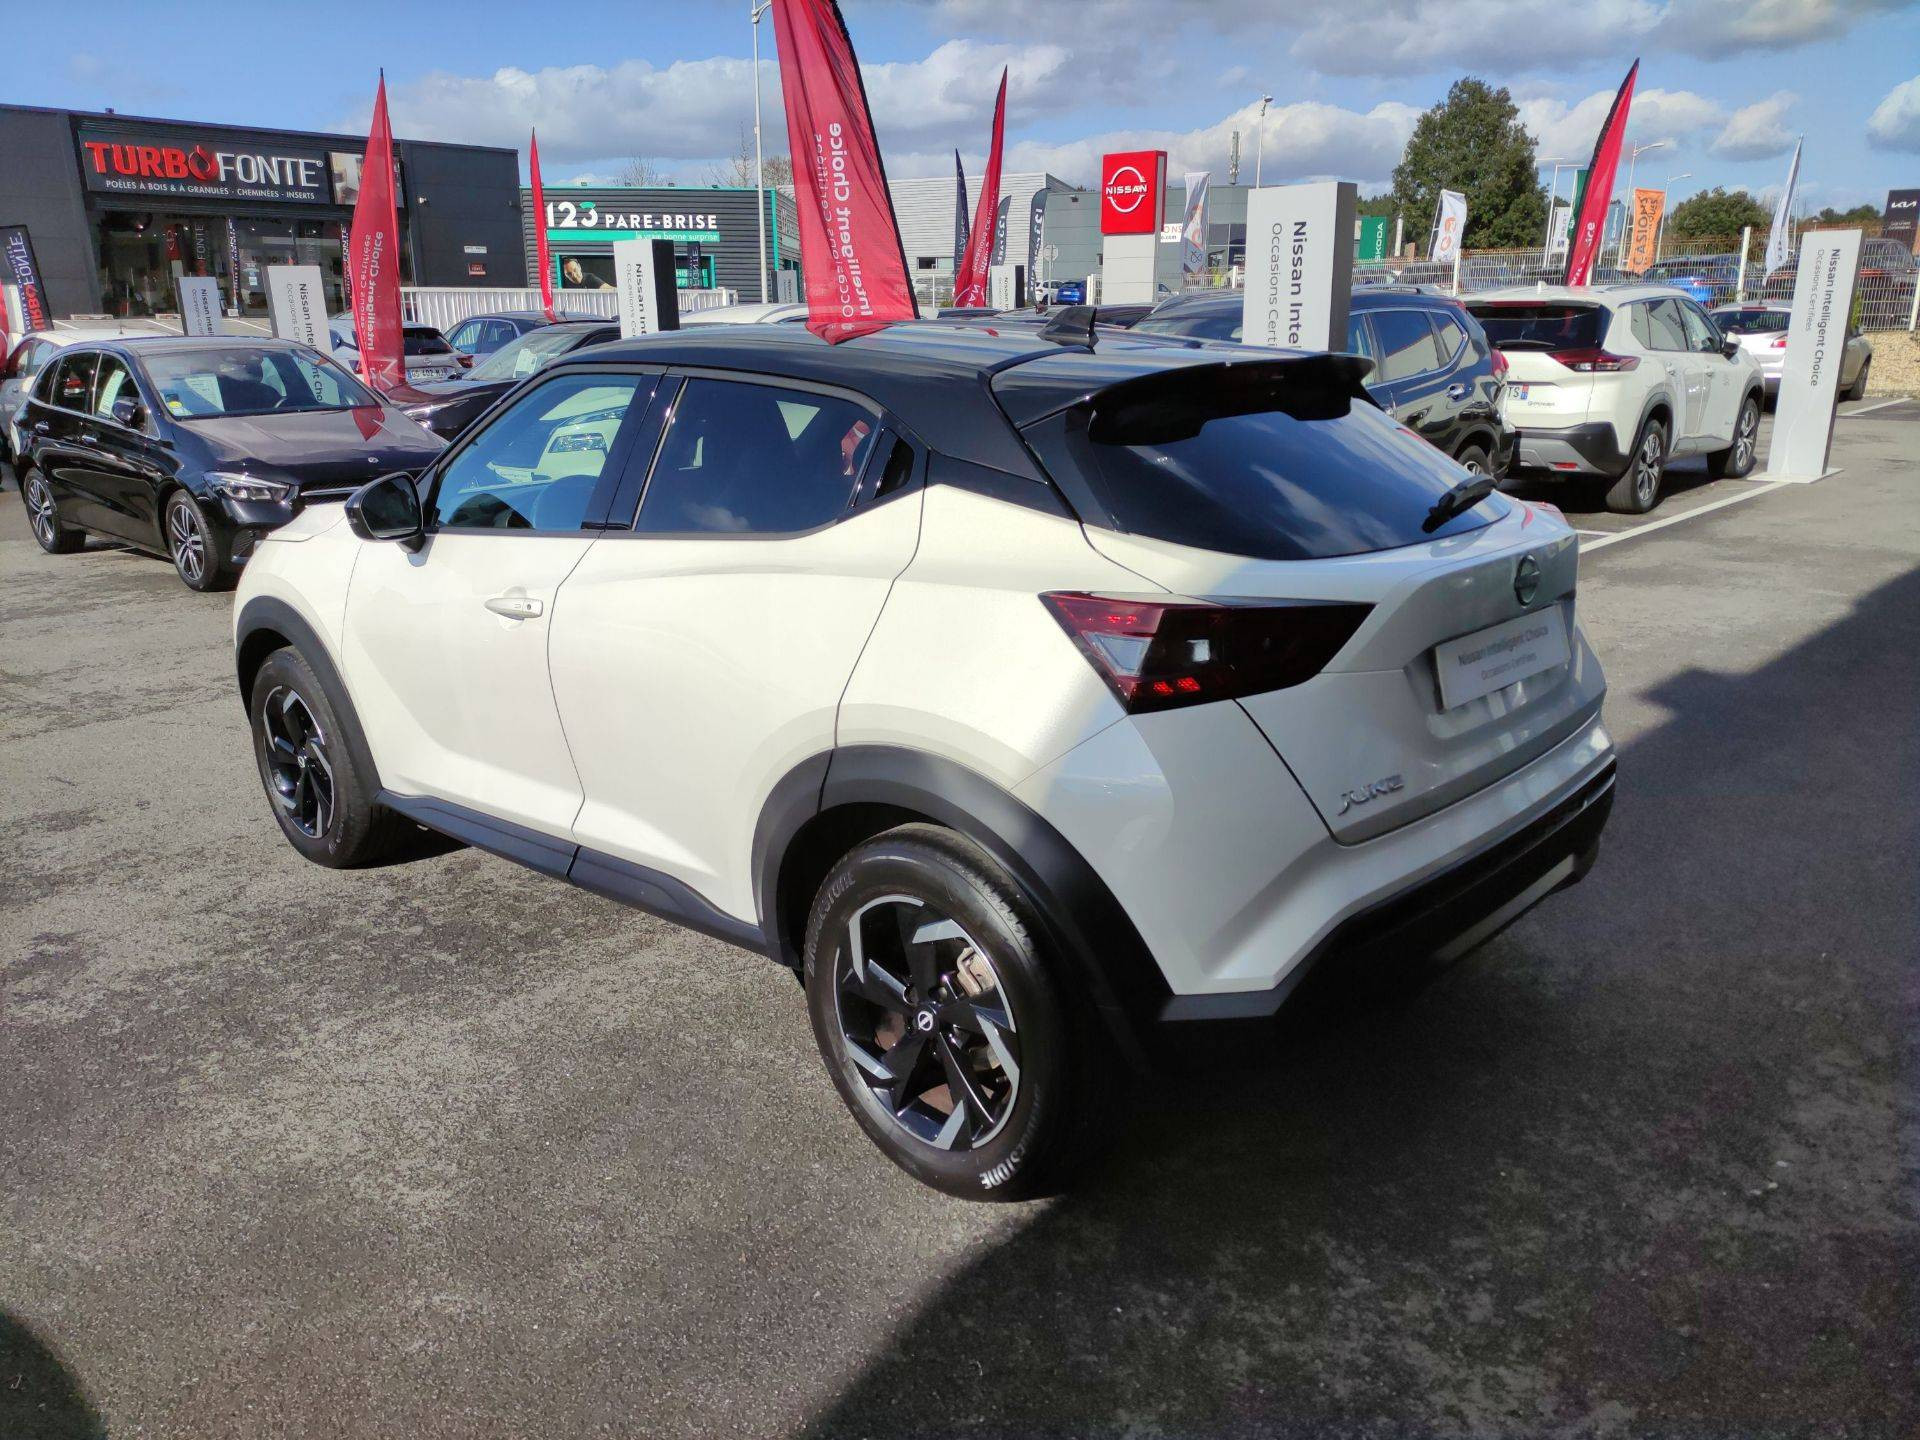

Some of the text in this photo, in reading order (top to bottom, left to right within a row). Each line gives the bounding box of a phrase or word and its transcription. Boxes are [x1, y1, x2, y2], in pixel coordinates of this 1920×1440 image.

[148, 182, 168, 192] BOIS
[169, 184, 178, 192] &
[187, 185, 229, 196] GRANULES
[286, 191, 315, 200] INSERTS
[1105, 184, 1148, 195] NISSAN
[1890, 200, 1918, 209] KIA
[546, 201, 718, 229] 123 PARE-BRISE
[663, 230, 687, 240] bonne
[688, 231, 719, 242] surprise
[1268, 222, 1282, 306] Occasions
[1290, 221, 1307, 296] Nissan
[1811, 248, 1825, 293] Occasions
[200, 288, 210, 315] Nissan
[299, 283, 311, 320] Nissan
[636, 263, 645, 312] Nissan
[1810, 248, 1841, 387] Nissan Intelligent Choice
[1337, 773, 1405, 817] JUKE
